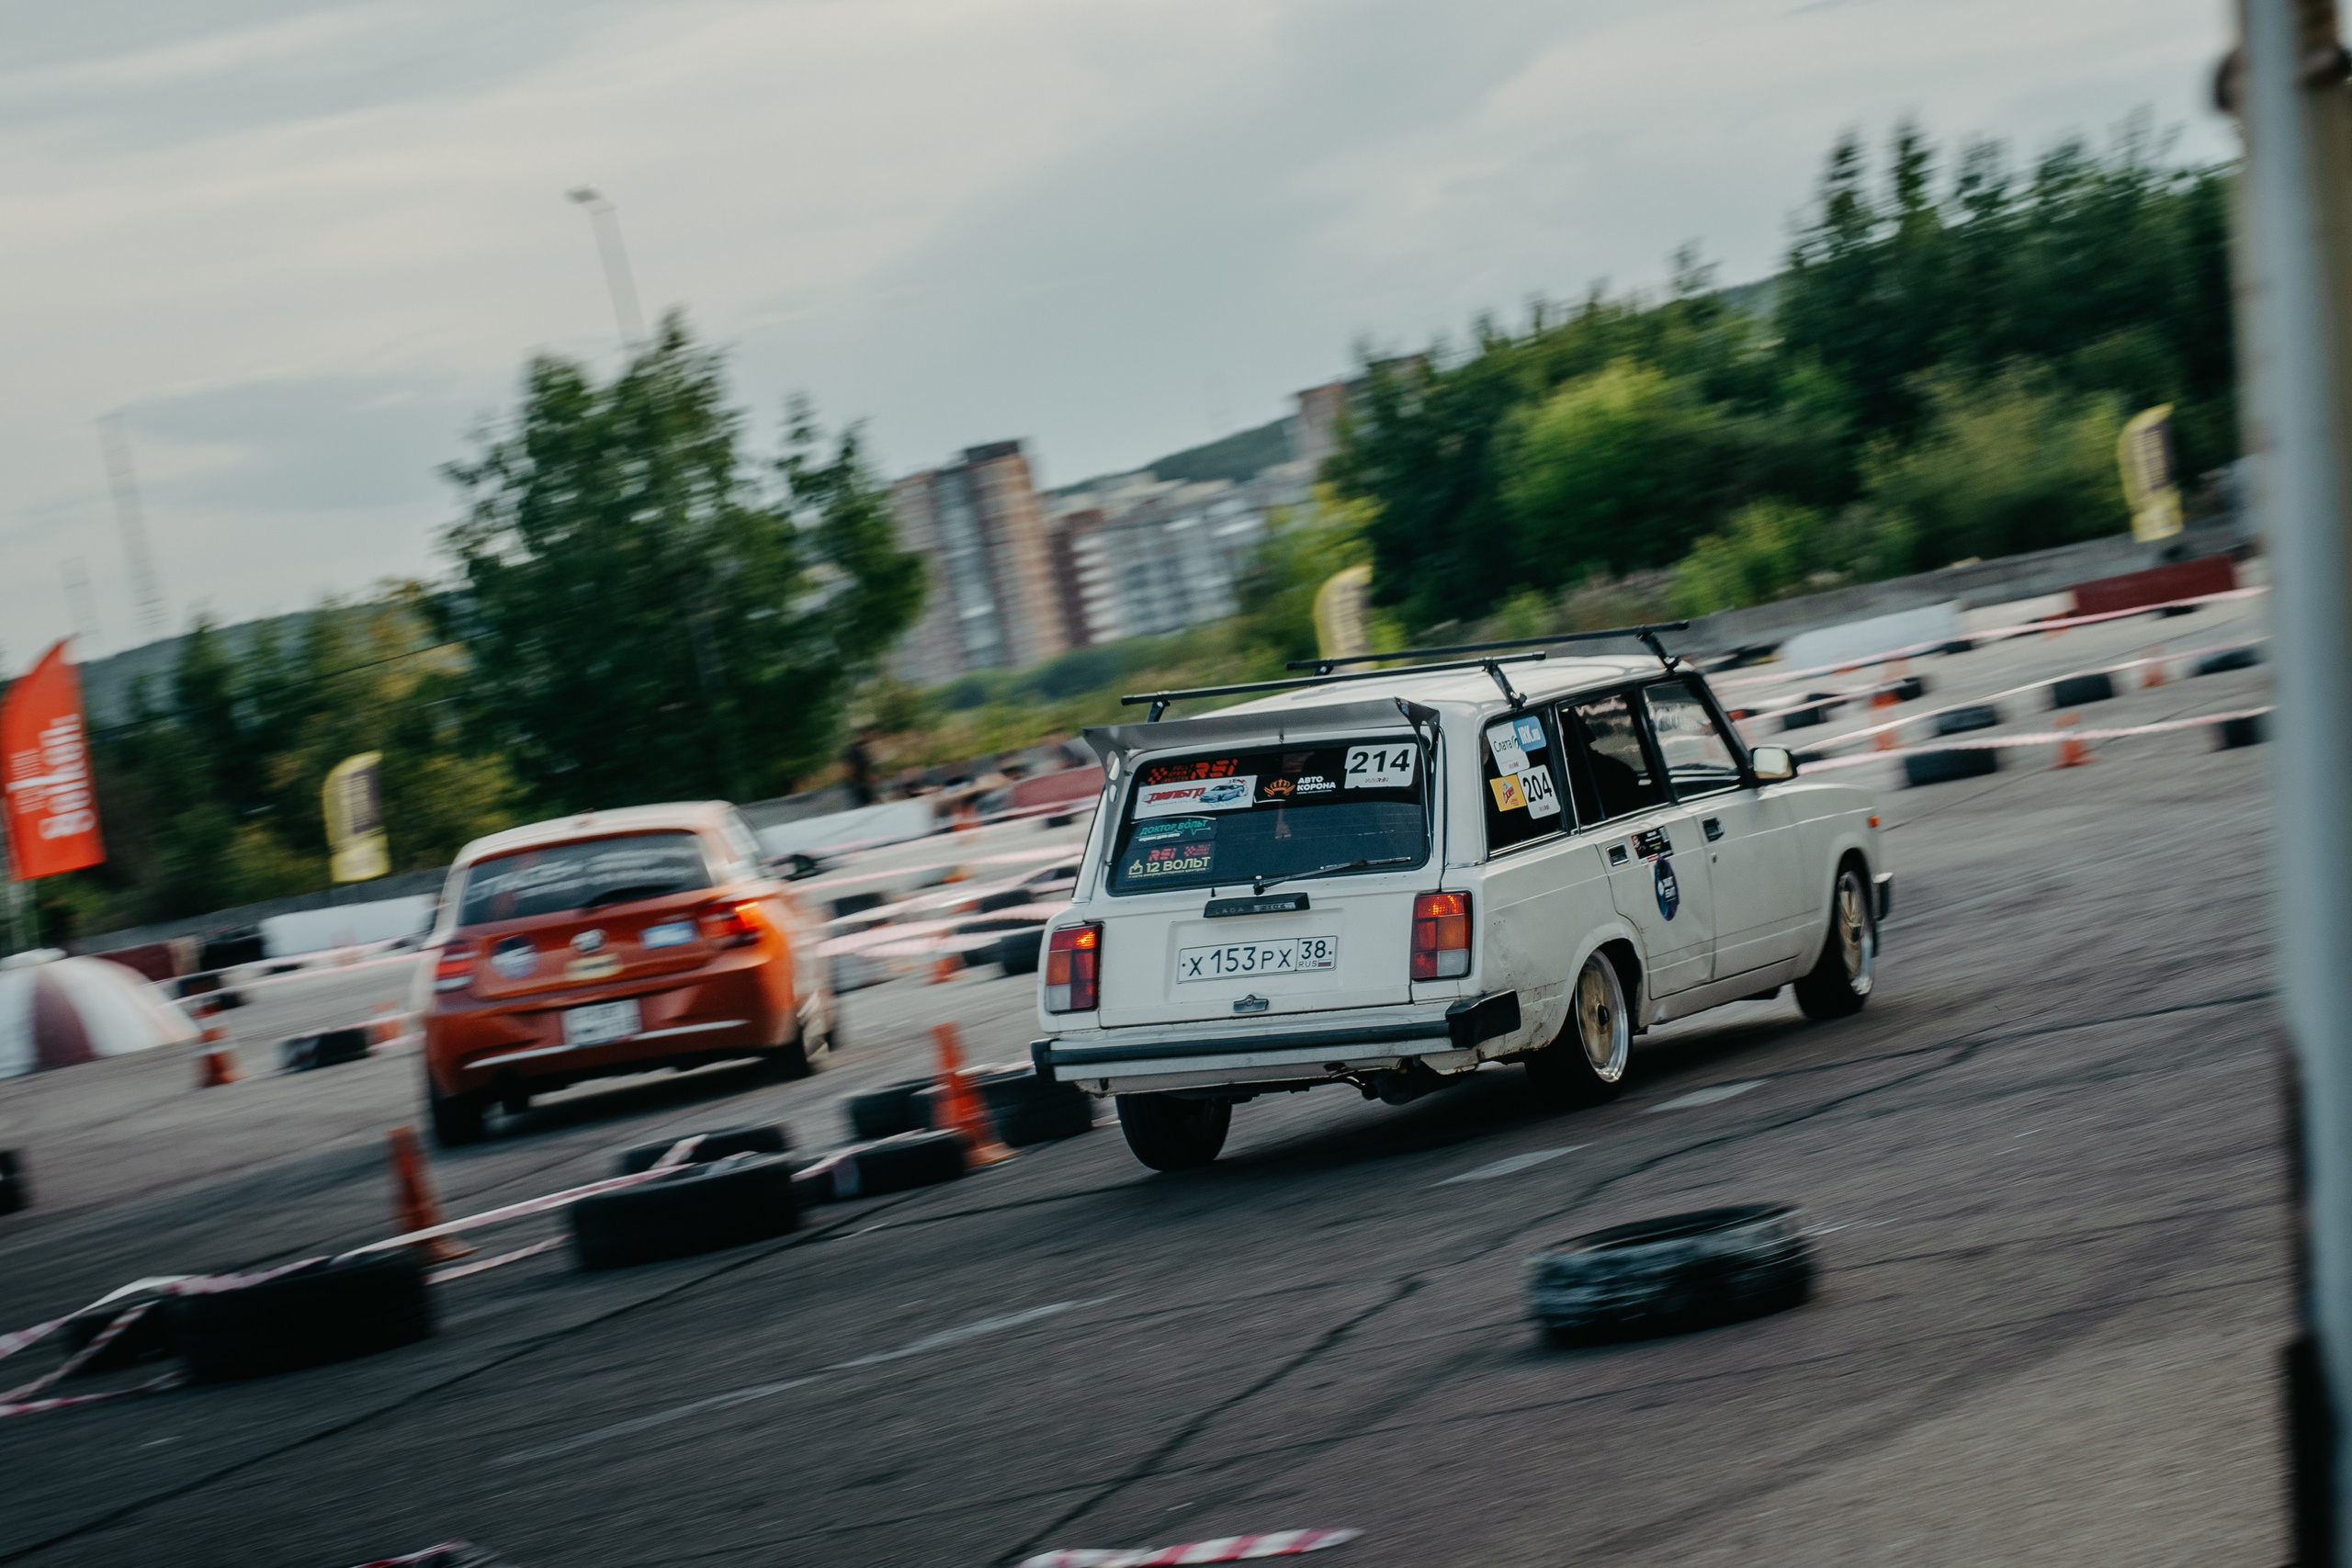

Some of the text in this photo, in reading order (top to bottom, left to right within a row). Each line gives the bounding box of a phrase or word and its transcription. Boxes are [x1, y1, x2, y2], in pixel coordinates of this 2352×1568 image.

[1494, 739, 1515, 752] Слата
[1349, 750, 1410, 774] 214
[1297, 776, 1324, 784] АВТО
[1296, 782, 1337, 792] КОРОНА
[1522, 772, 1553, 803] 204
[1140, 824, 1177, 835] ДОКТОР
[1146, 862, 1160, 873] 12
[1162, 856, 1211, 871] ВОЛЬТ
[1301, 940, 1326, 960] 38
[1298, 960, 1317, 968] RUS
